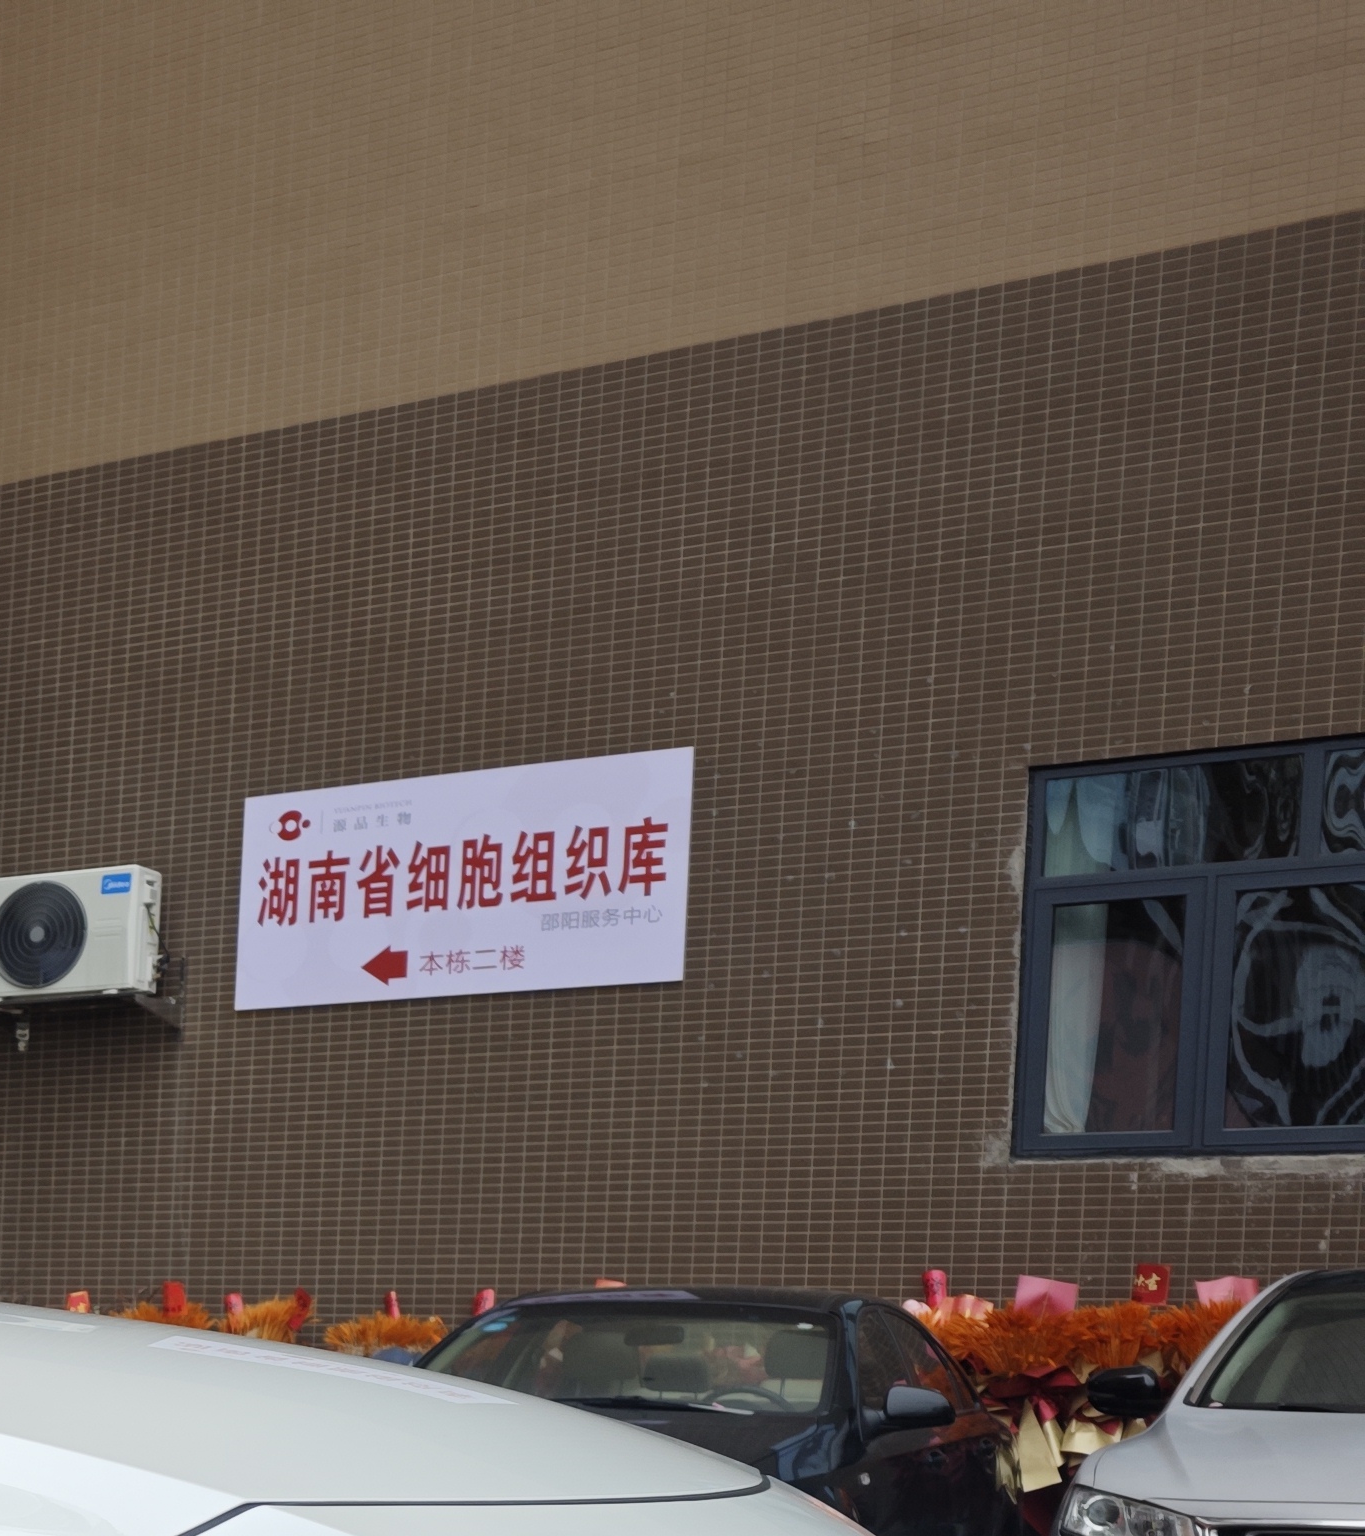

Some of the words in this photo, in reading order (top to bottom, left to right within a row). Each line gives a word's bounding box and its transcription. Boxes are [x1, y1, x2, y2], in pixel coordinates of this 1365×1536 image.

[257, 815, 669, 927] 湖南省细胞组织库
[539, 904, 664, 933] 邵阳服务中心
[417, 945, 527, 976] 本栋二楼
